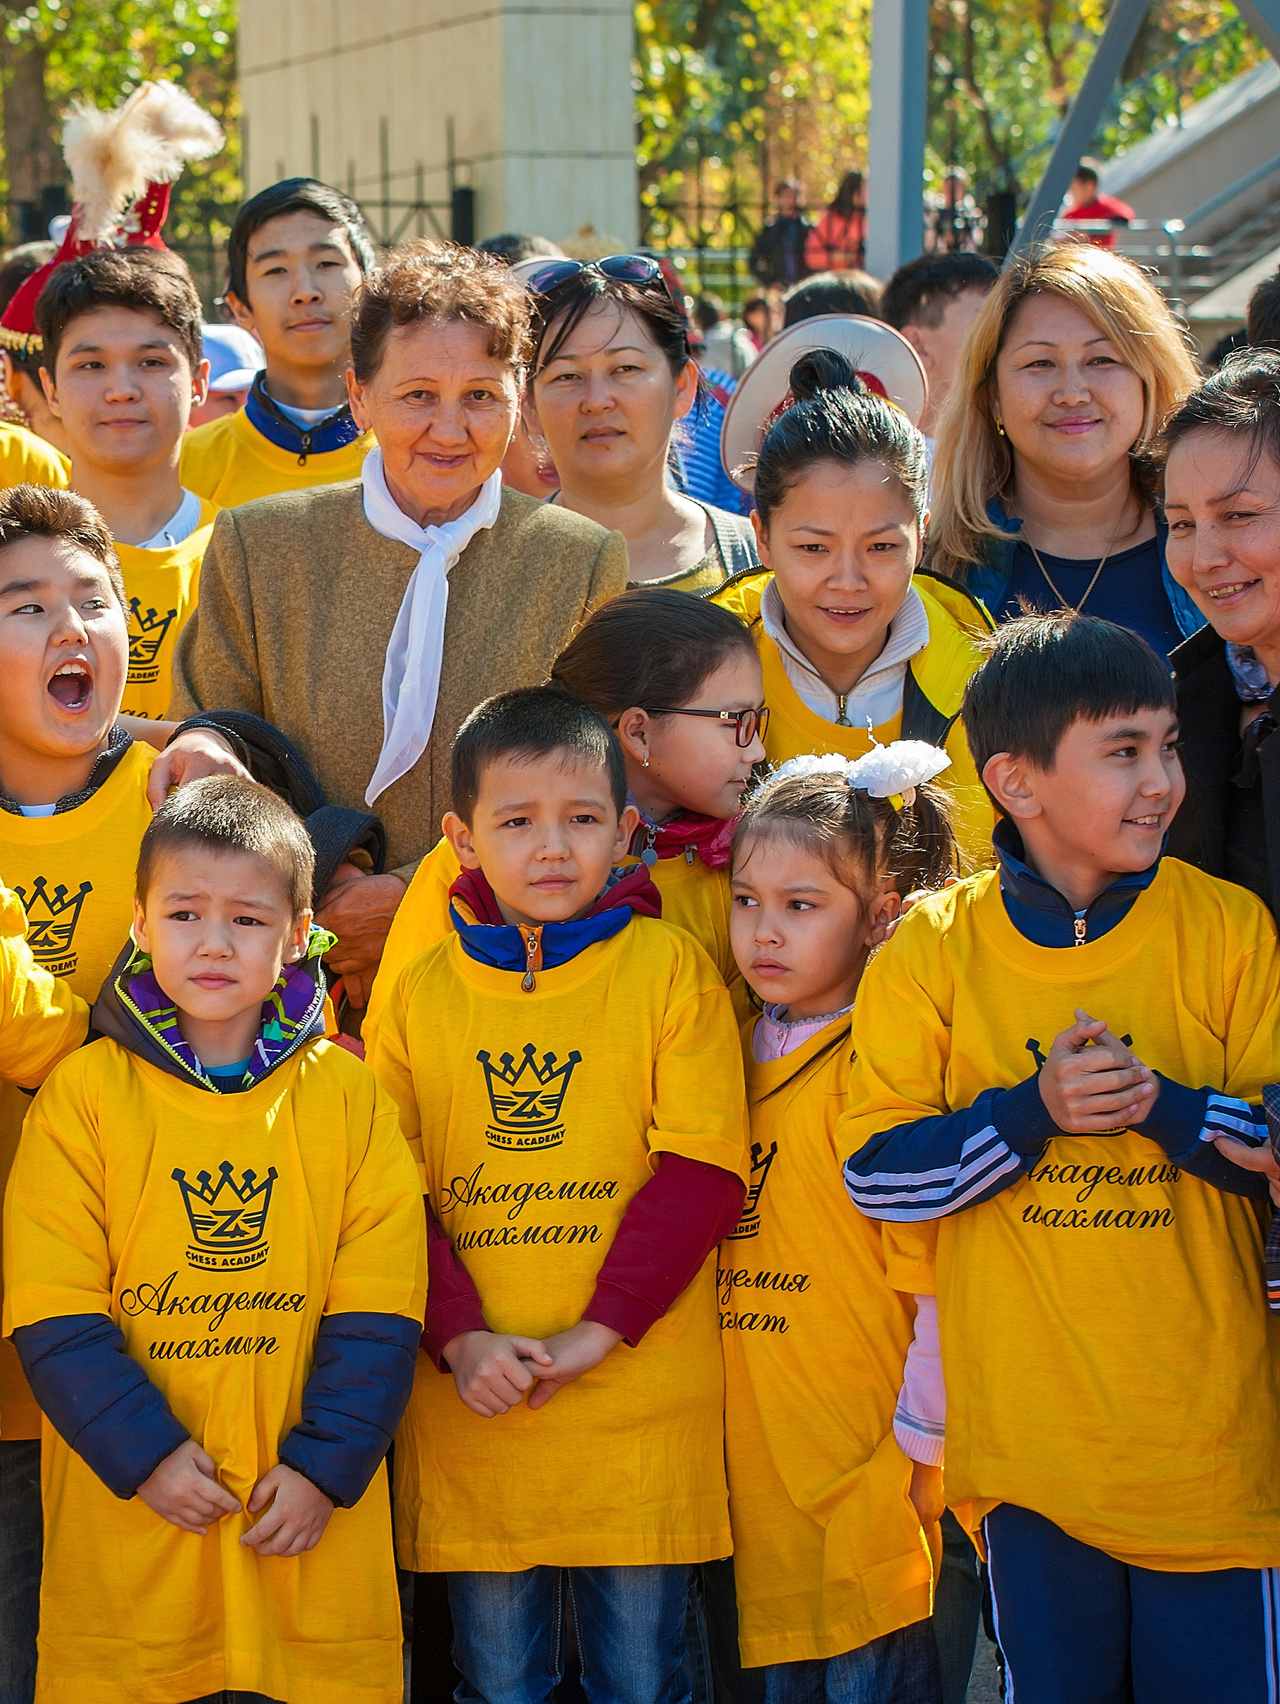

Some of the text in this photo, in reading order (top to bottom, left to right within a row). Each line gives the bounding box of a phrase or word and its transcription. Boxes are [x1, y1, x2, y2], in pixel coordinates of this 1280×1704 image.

[484, 1128, 567, 1146] CHESS ACADEMY
[440, 1161, 620, 1221] Академия
[456, 1224, 603, 1252] шахмат
[184, 1245, 271, 1267] CHESS ACADEMY
[120, 1270, 307, 1333] Академия
